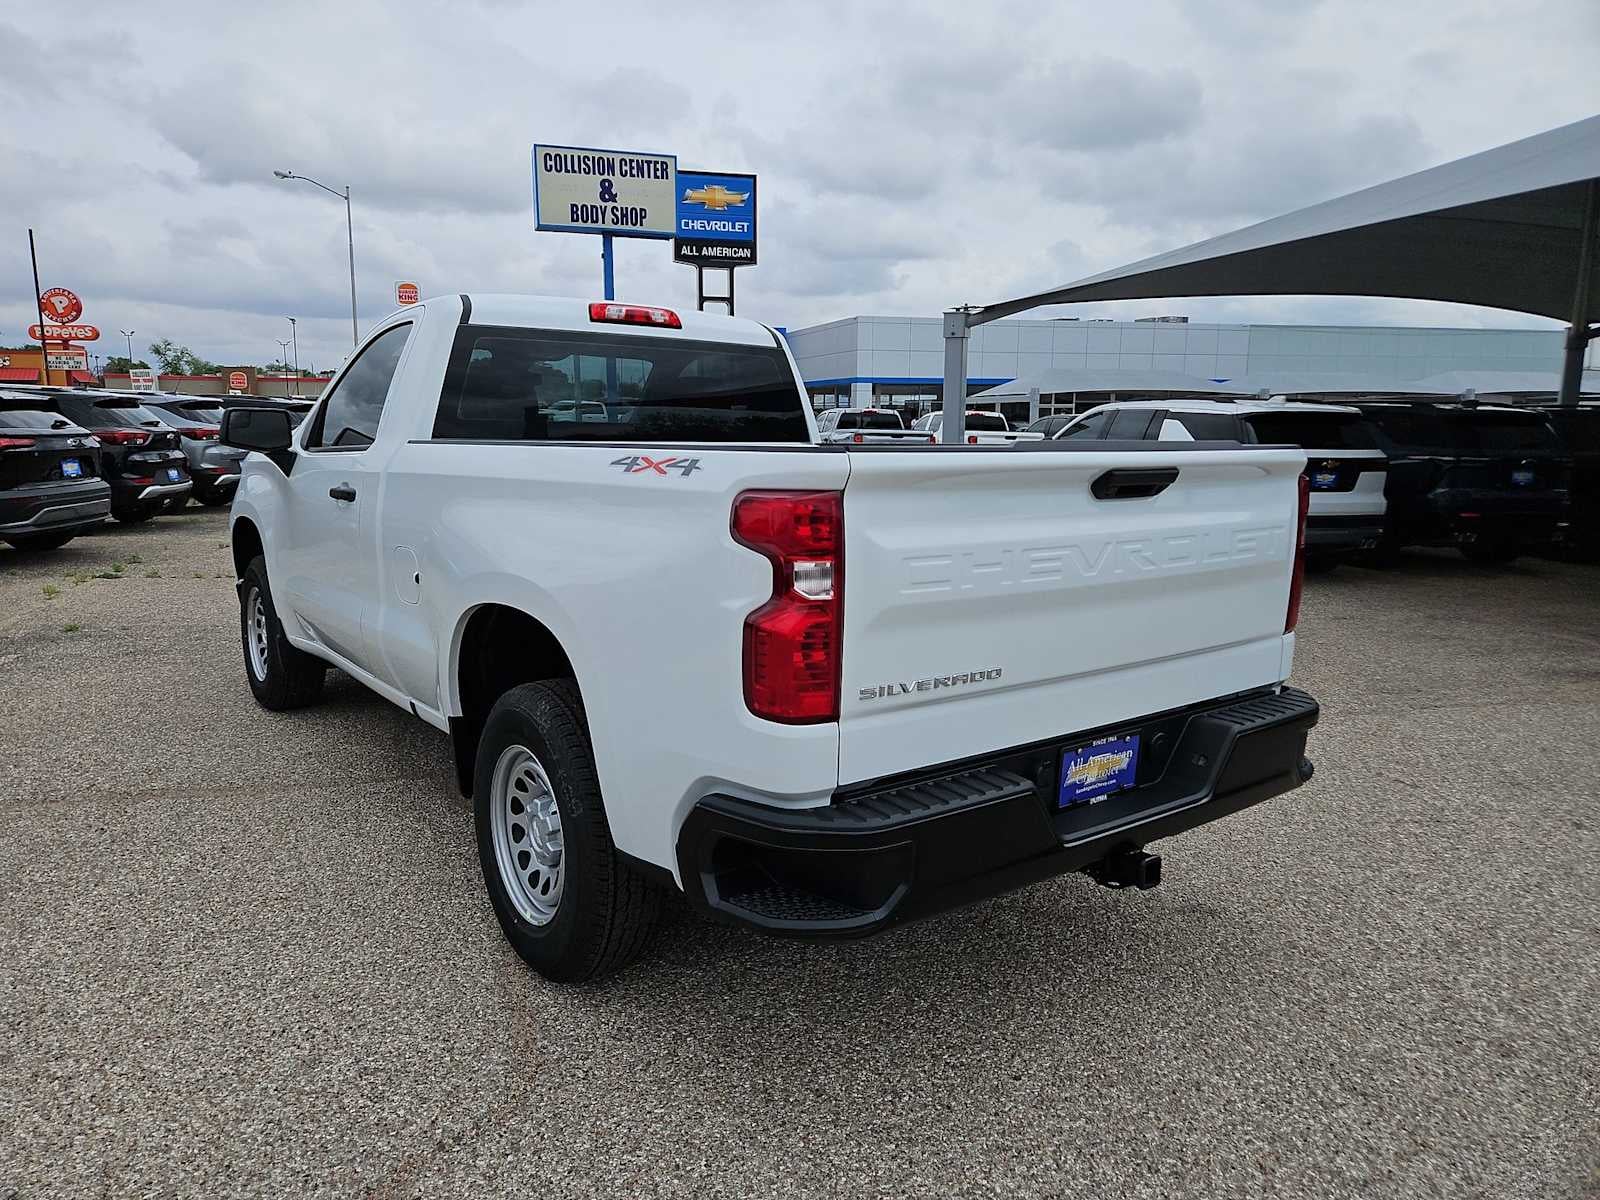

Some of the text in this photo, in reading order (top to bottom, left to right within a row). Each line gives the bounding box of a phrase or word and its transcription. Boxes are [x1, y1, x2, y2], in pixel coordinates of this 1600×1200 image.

[543, 152, 669, 180] COLLISION CENTER
[599, 178, 618, 203] &
[570, 203, 647, 227] BODY SHOP
[681, 219, 750, 233] CHEVROLET
[681, 245, 751, 258] ALL AMERICAN
[41, 289, 77, 304] LOUISIANA
[50, 295, 69, 314] P
[44, 310, 77, 323] KITCHEN
[900, 526, 1287, 594] CHEVROLET
[859, 668, 1002, 701] SILVERADO
[1084, 750, 1133, 767] American
